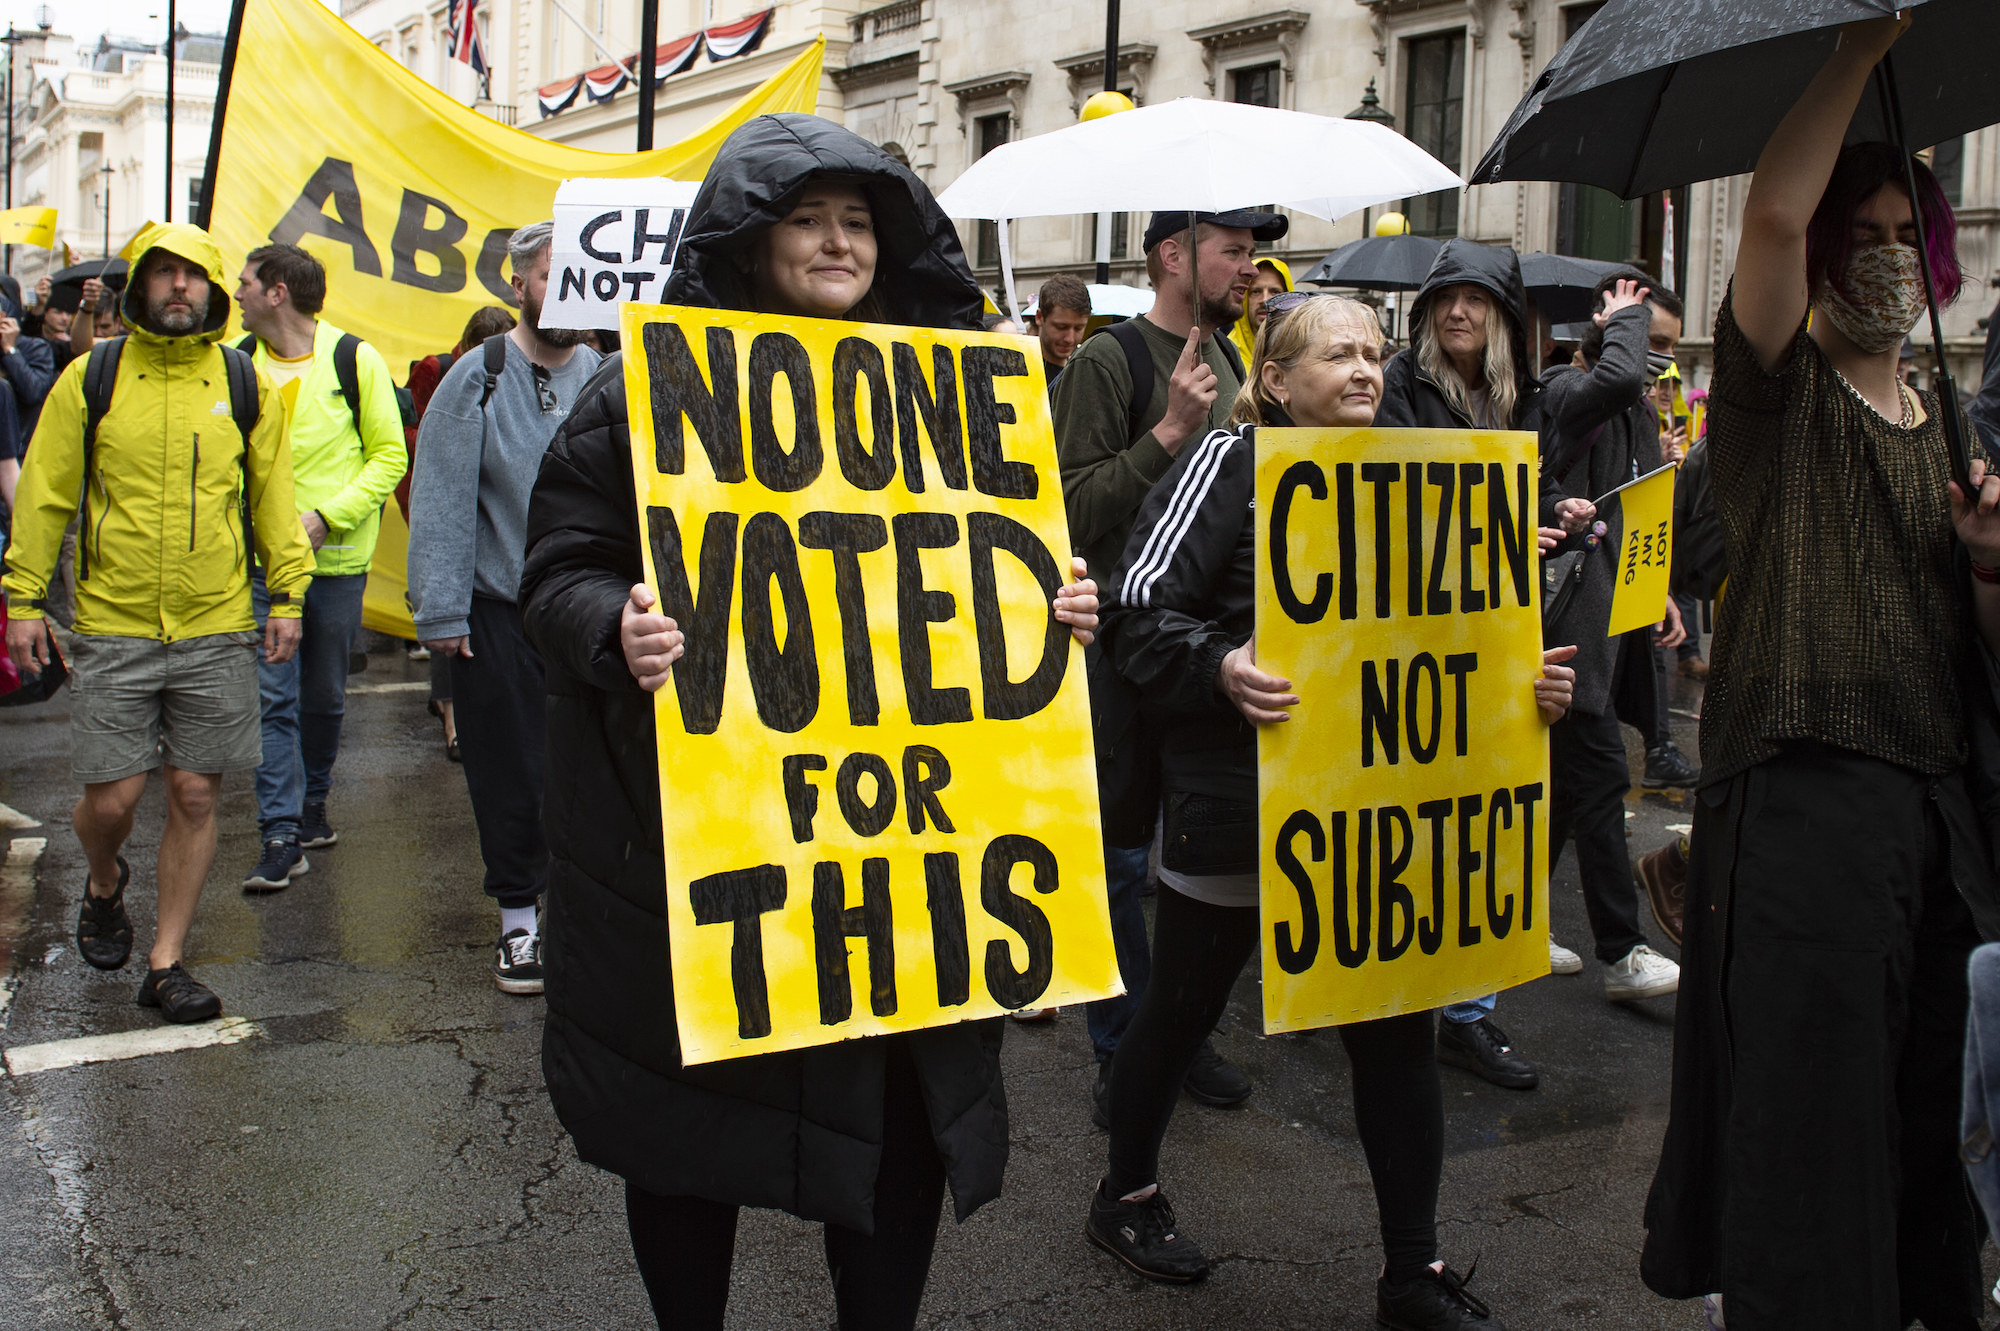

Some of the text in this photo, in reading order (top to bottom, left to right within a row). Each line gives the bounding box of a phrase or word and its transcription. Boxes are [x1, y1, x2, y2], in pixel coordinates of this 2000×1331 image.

[558, 266, 656, 302] NOT
[643, 322, 1039, 500] NO ONE
[1269, 460, 1531, 625] CITIZEN
[1624, 529, 1640, 586] KING
[1641, 533, 1653, 567] MY
[1655, 520, 1668, 568] NOT
[646, 505, 1070, 735] VOTED
[1361, 651, 1478, 768] NOT
[782, 744, 957, 844] FOR
[1273, 781, 1544, 975] SUBJECT
[689, 834, 1060, 1040] THIS
